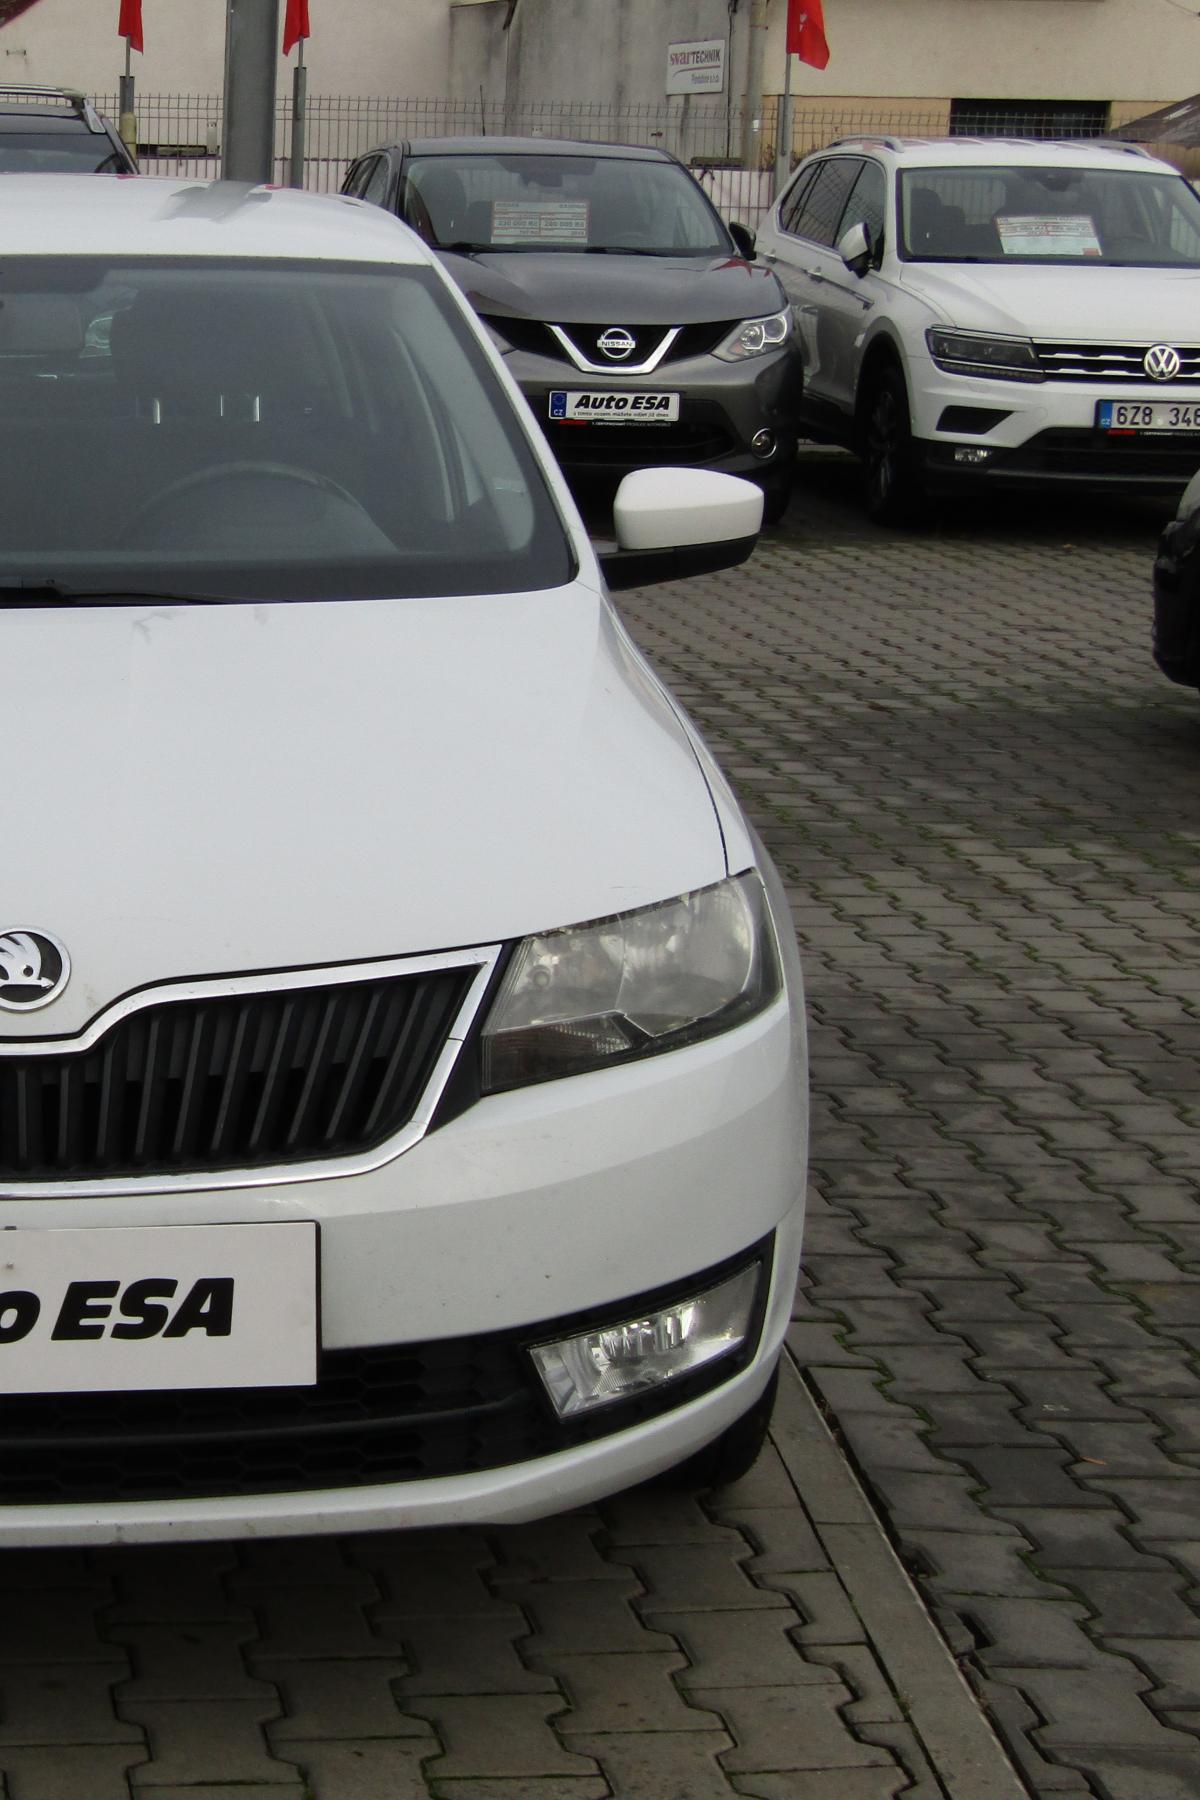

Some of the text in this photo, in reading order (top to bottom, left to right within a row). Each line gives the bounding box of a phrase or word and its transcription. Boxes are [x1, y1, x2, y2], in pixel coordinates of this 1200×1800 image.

[575, 395, 670, 410] Auto ESA
[1116, 406, 1153, 425] 6Z8
[51, 1278, 234, 1340] ESA
